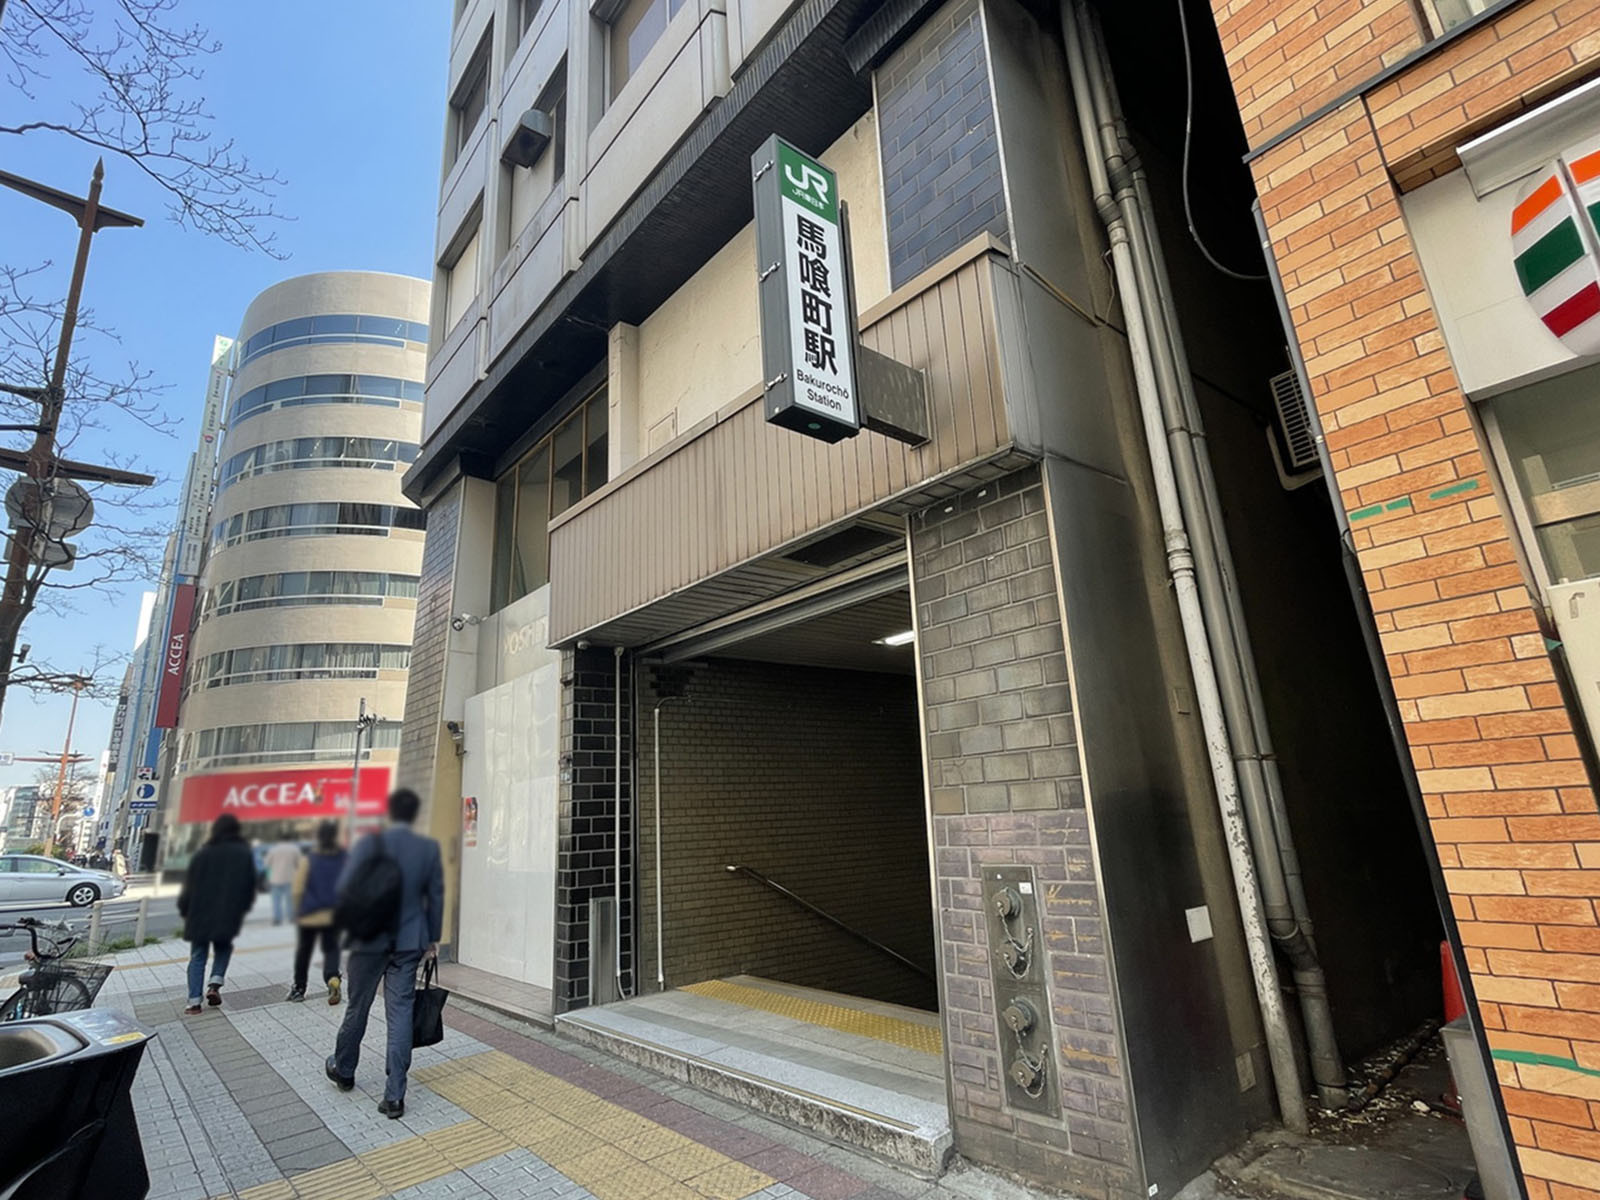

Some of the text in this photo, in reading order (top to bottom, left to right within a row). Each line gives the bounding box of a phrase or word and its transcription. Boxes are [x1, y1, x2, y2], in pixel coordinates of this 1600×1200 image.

[784, 163, 830, 205] JR
[796, 213, 838, 376] 馬喰町駅
[806, 388, 842, 411] Station
[167, 633, 185, 676] ACCEA
[222, 782, 315, 808] ACCEA
